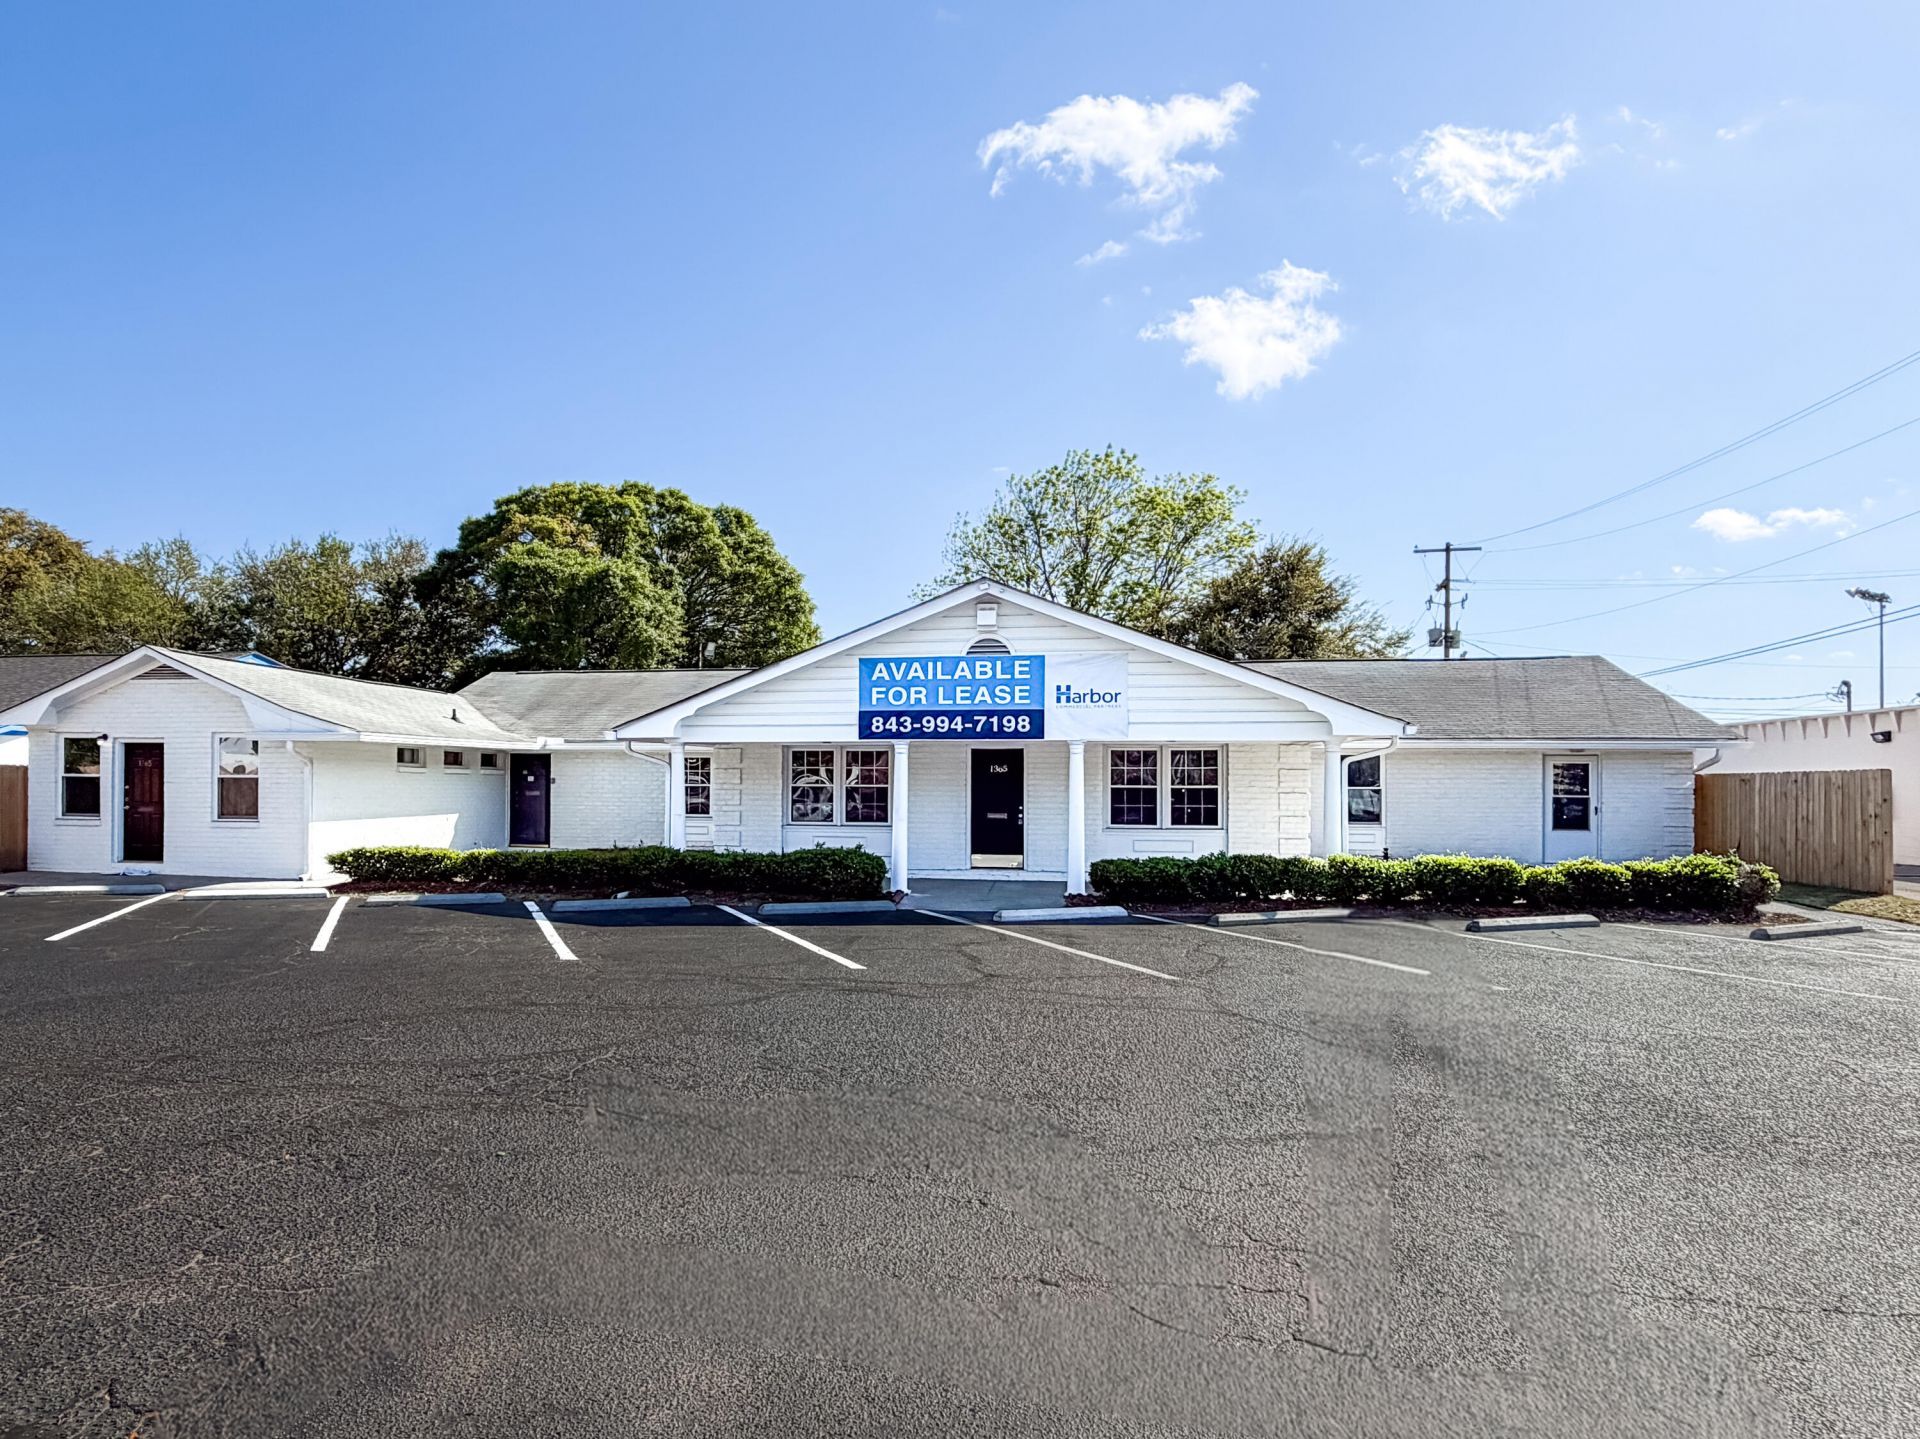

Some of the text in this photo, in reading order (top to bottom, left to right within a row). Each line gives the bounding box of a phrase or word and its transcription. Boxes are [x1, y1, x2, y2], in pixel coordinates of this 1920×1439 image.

[871, 660, 1031, 681] AVAILABLE
[871, 685, 1031, 705] FOR LEASE
[1056, 684, 1121, 703] Harbor
[871, 715, 1031, 733] 843-994-7198
